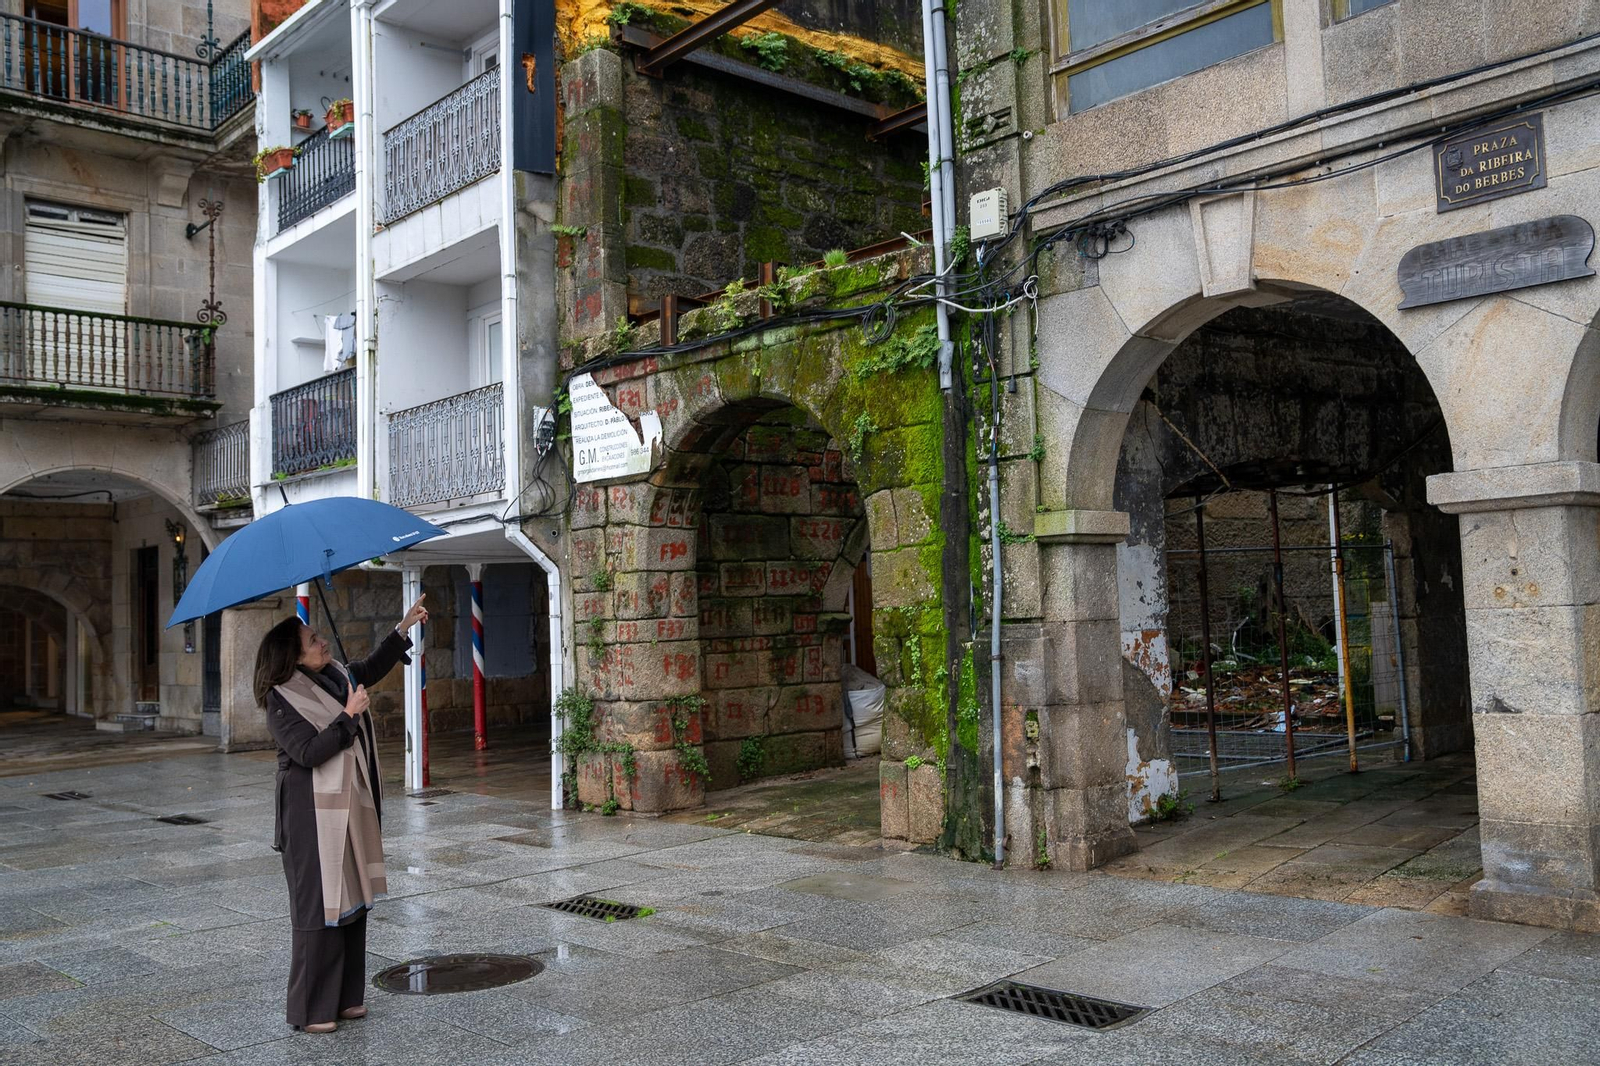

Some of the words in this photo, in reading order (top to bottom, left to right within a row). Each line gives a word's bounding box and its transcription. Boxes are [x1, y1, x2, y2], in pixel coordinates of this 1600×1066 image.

[1473, 134, 1519, 156] PRAZA
[1460, 165, 1474, 178] DA
[1479, 148, 1534, 173] RIBEIRA
[1455, 182, 1470, 195] DO
[1421, 244, 1565, 302] TURISTA
[595, 434, 601, 442] LA
[578, 447, 600, 466] G.M.
